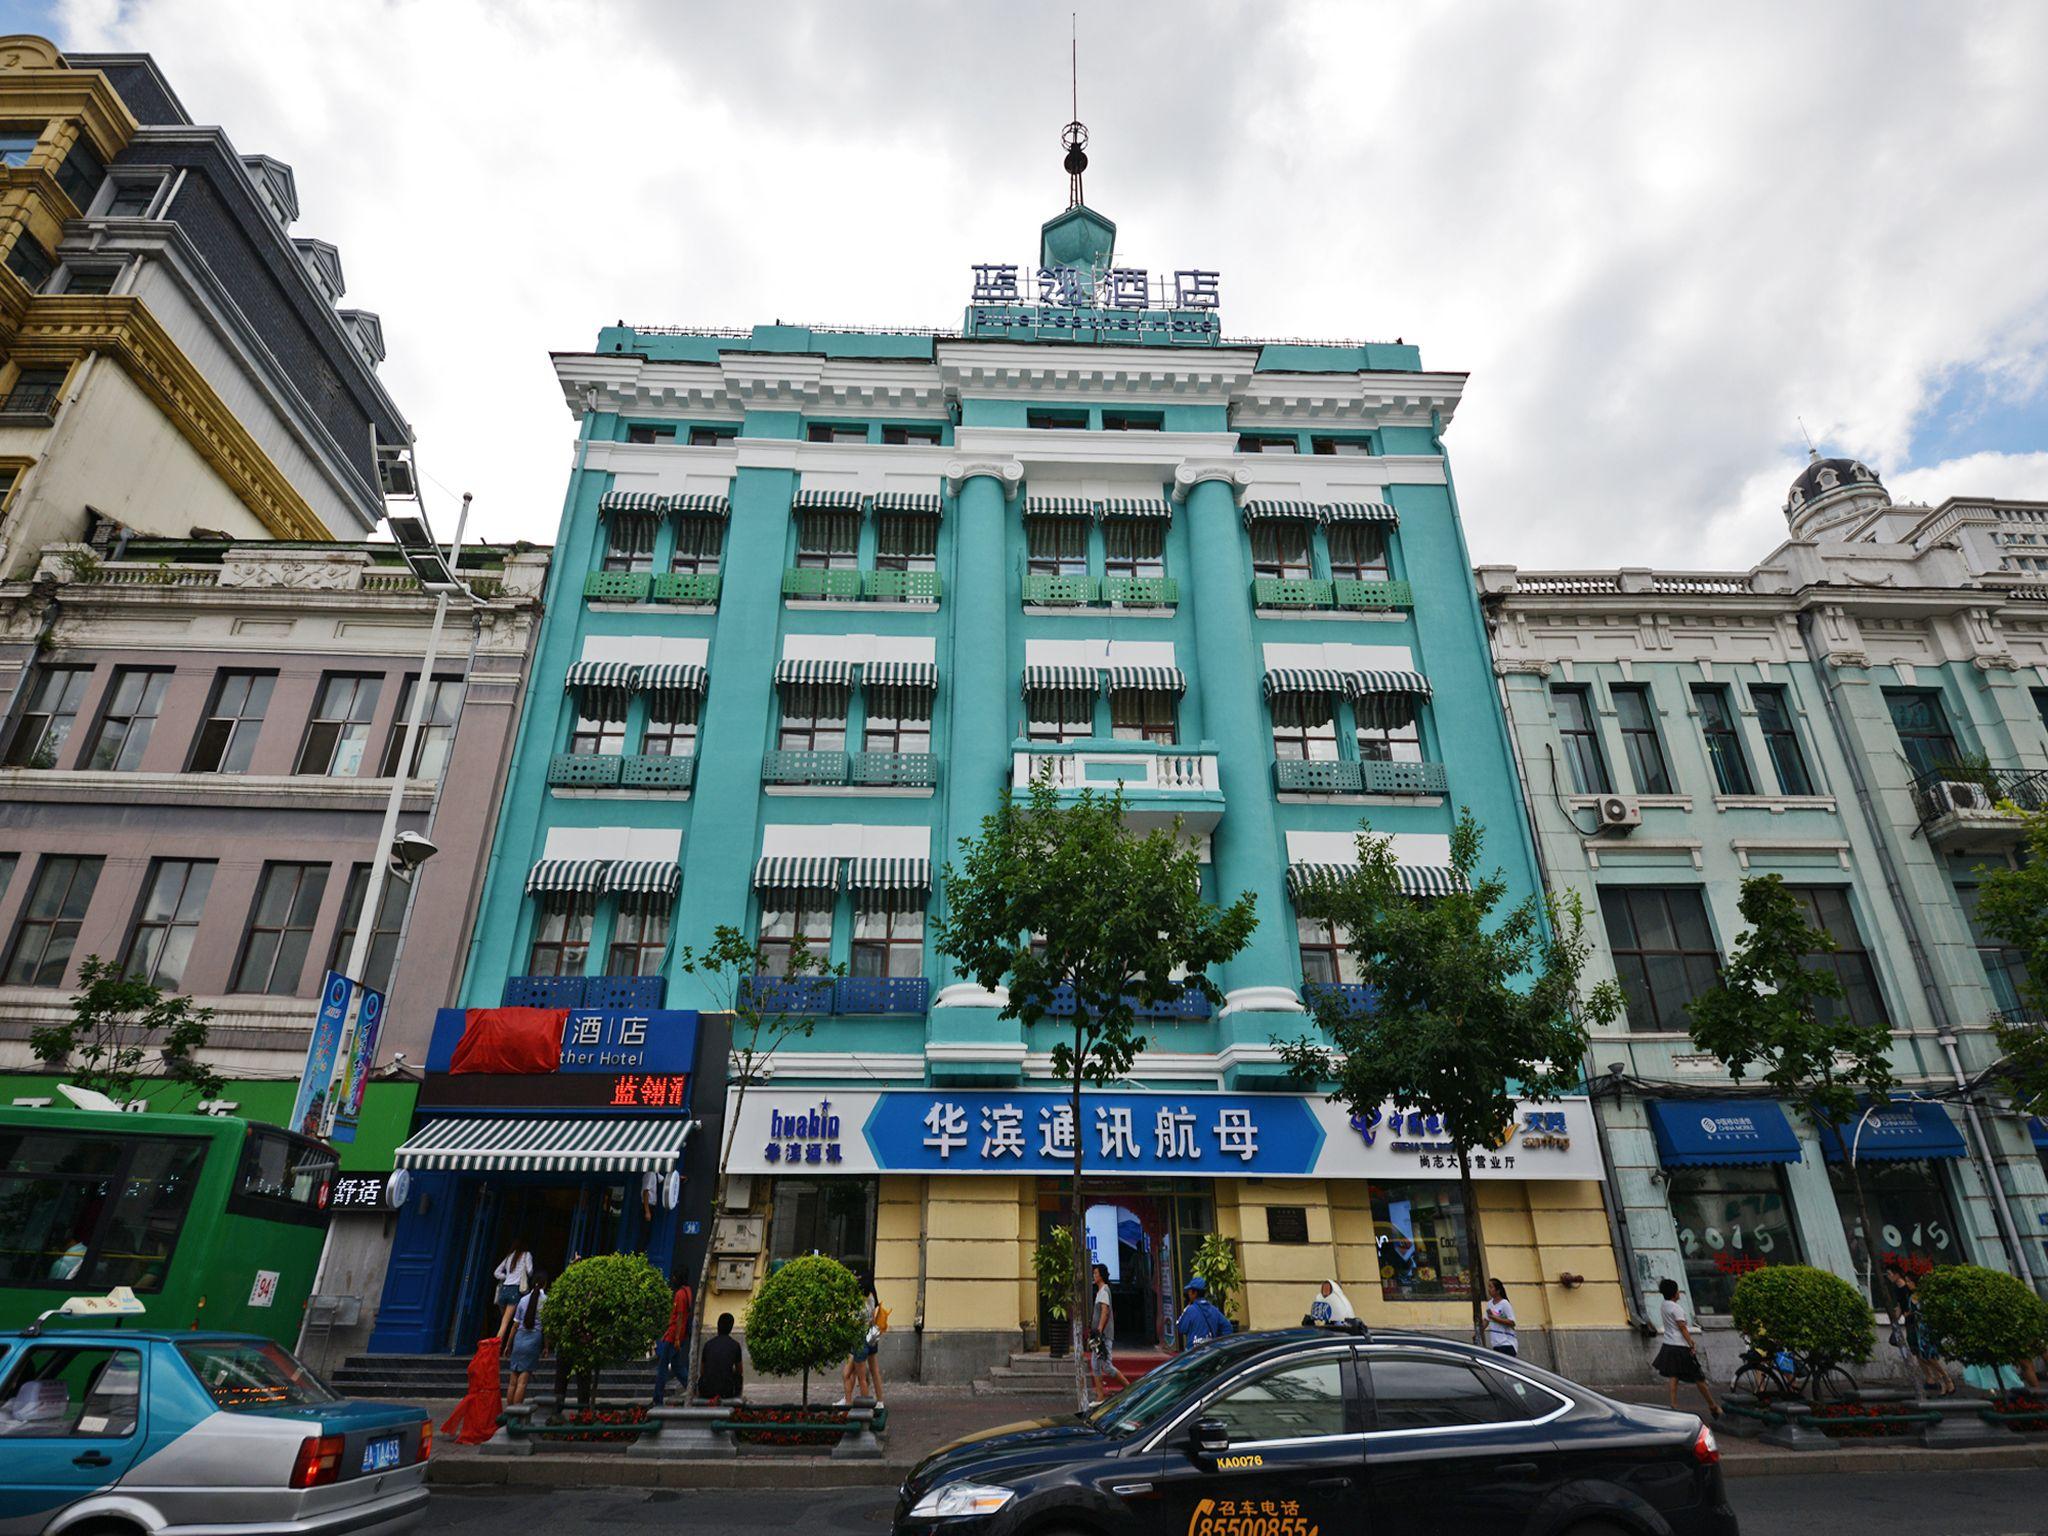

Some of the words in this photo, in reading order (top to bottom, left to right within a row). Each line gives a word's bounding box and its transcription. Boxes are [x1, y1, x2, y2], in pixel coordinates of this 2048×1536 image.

[975, 309, 1031, 327] Blue
[1041, 309, 1143, 331] Feather
[600, 1052, 643, 1066] Hotel
[923, 1101, 1259, 1161] 华滨通讯航母
[333, 1178, 381, 1205] 舒适
[1680, 1223, 1775, 1253] 2015
[1216, 1455, 1264, 1469] KA0076
[1217, 1500, 1300, 1517] 召车电话
